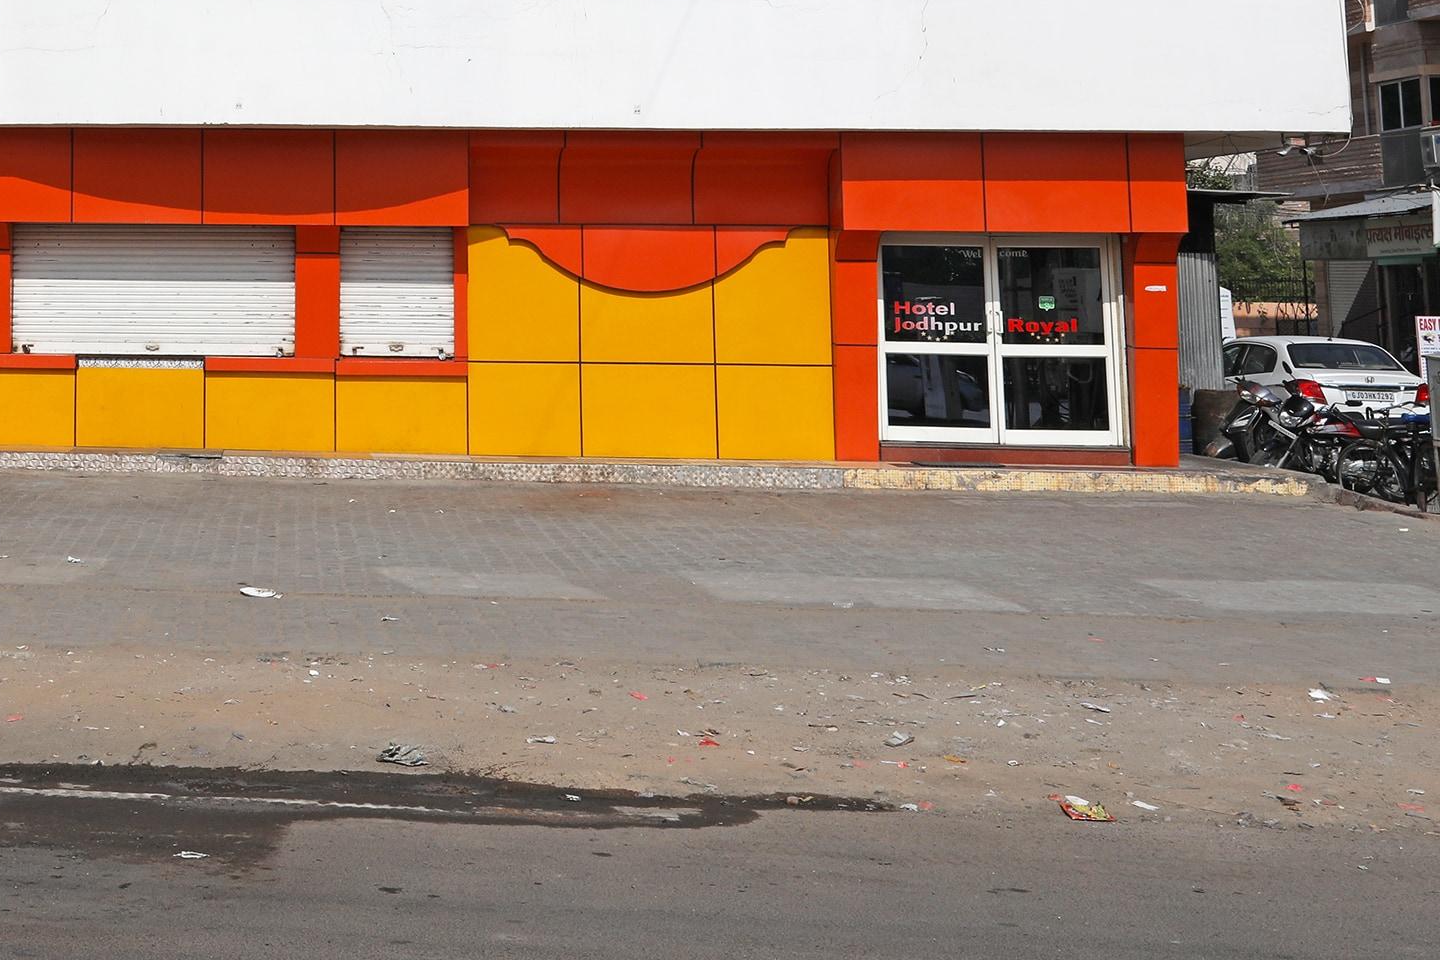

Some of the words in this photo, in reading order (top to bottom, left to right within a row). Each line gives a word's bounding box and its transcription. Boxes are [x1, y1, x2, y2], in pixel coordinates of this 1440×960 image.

[959, 248, 982, 258] Wel
[999, 249, 1029, 258] come
[894, 300, 955, 316] Hotel
[893, 316, 982, 335] Jodhpur
[1007, 318, 1078, 335] Royal
[1419, 318, 1436, 331] EASY
